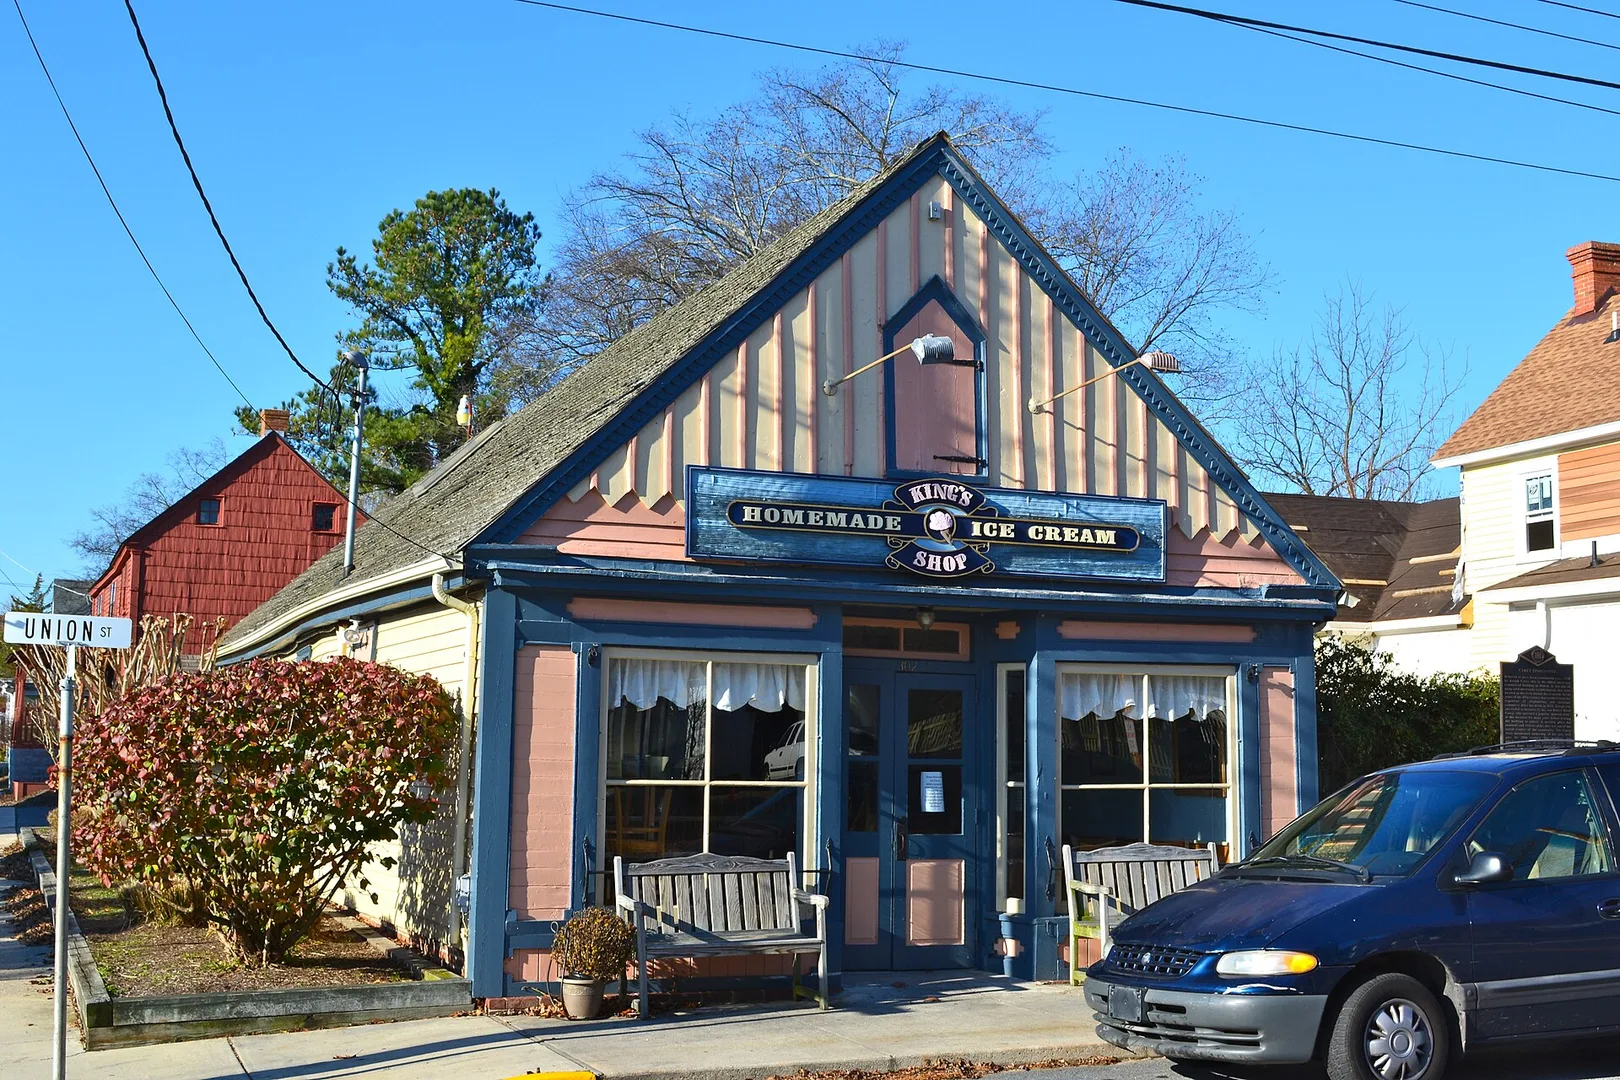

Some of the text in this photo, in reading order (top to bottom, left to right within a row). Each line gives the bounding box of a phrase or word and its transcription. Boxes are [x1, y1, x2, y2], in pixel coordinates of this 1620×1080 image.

[908, 483, 973, 507] KING'S
[742, 506, 1116, 545] HOMEMADE ICE CREAM
[913, 551, 967, 572] SHOP
[25, 617, 112, 642] UNION ST
